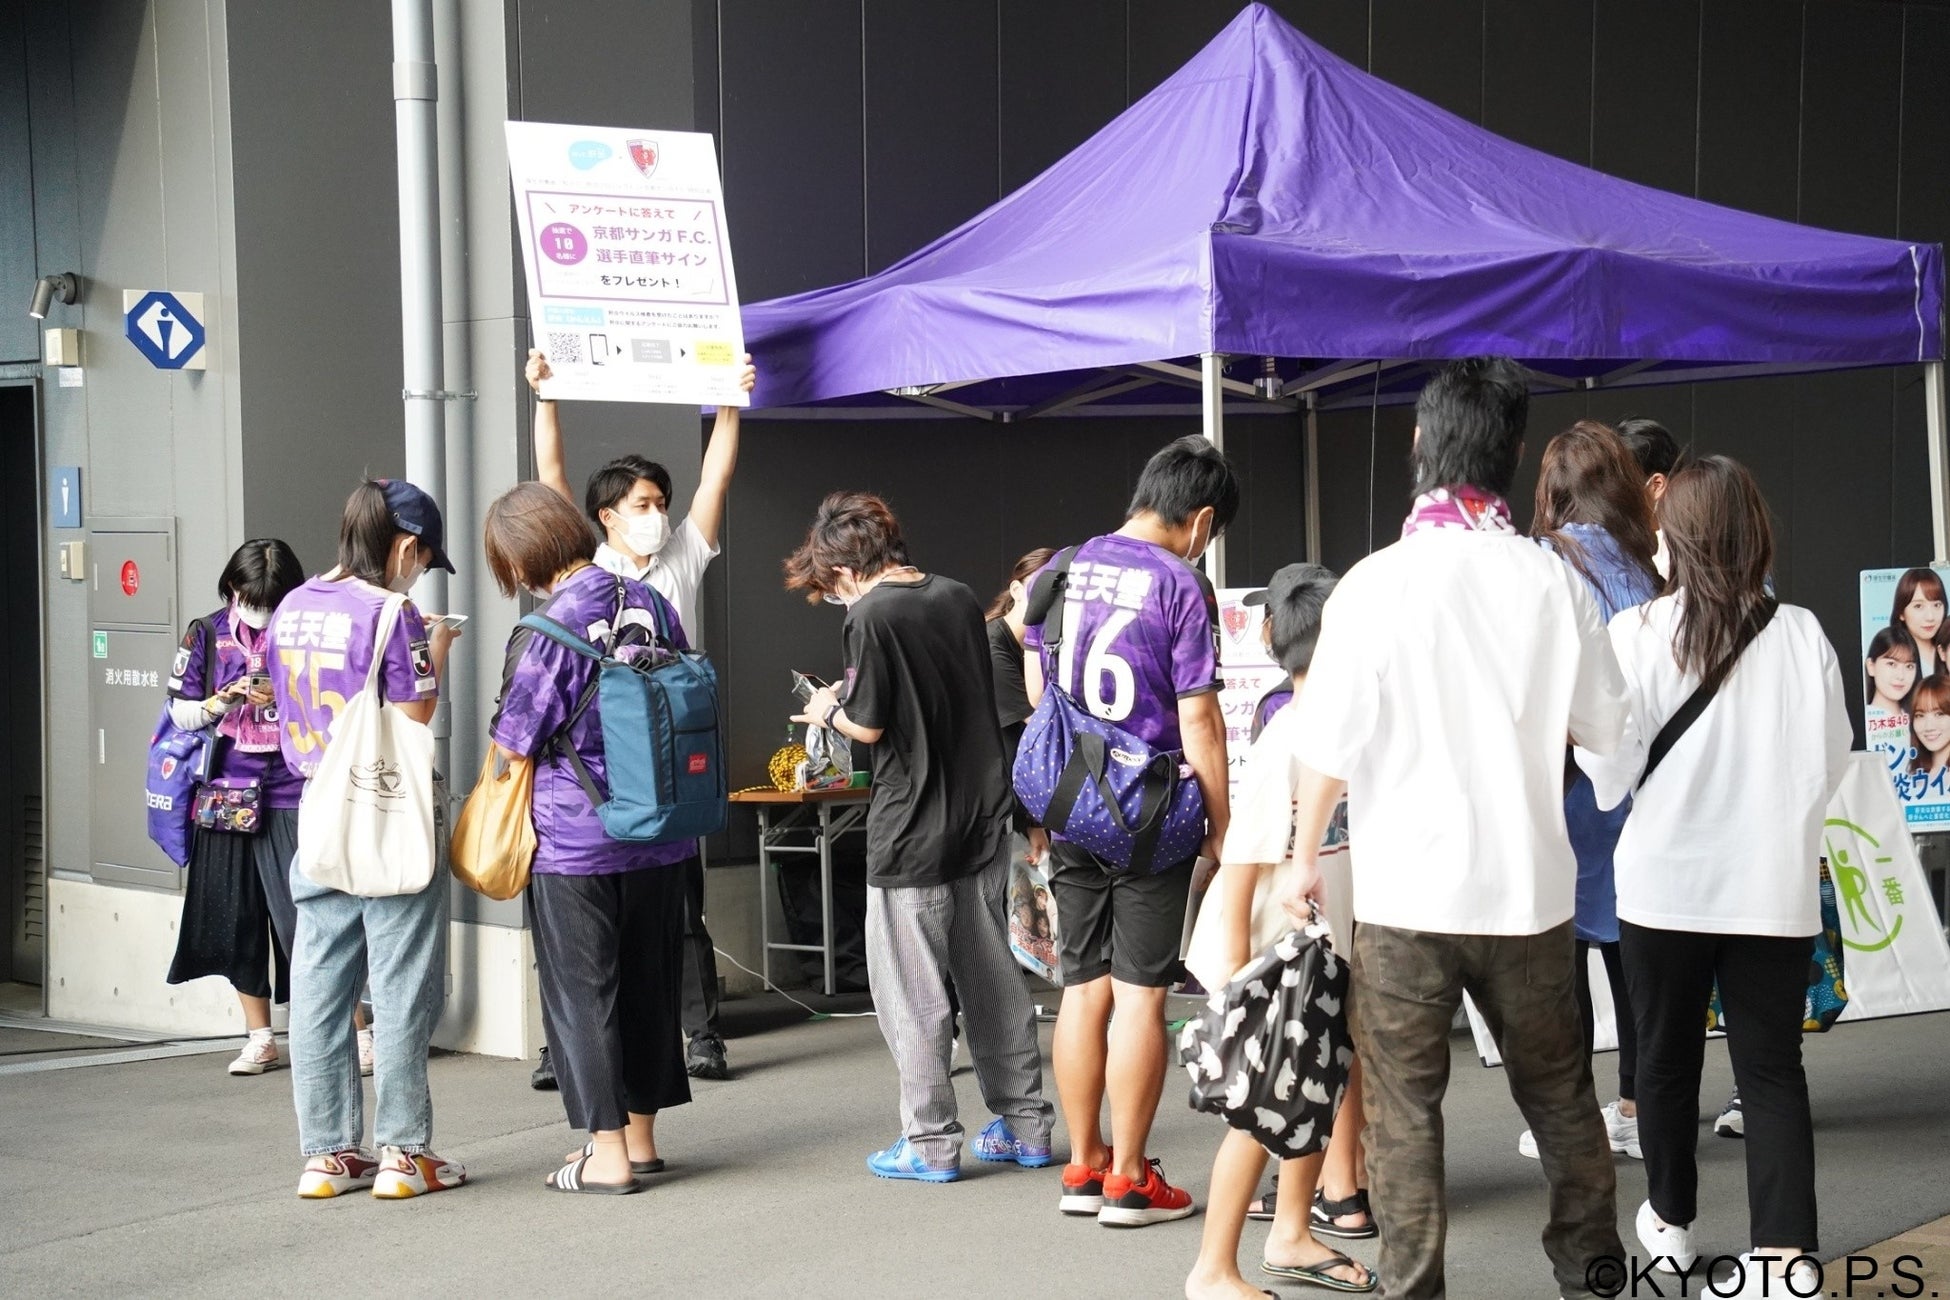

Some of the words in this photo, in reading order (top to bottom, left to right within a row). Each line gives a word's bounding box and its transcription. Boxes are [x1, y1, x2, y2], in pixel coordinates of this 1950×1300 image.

[569, 203, 675, 219] アンケートに答えて
[554, 237, 574, 250] 10
[596, 248, 707, 267] 選手直筆サイン
[274, 609, 353, 651] 任天堂
[1058, 598, 1138, 722] 16
[104, 667, 159, 687] 消火用散水栓
[1868, 714, 1909, 732] 乃木坂46
